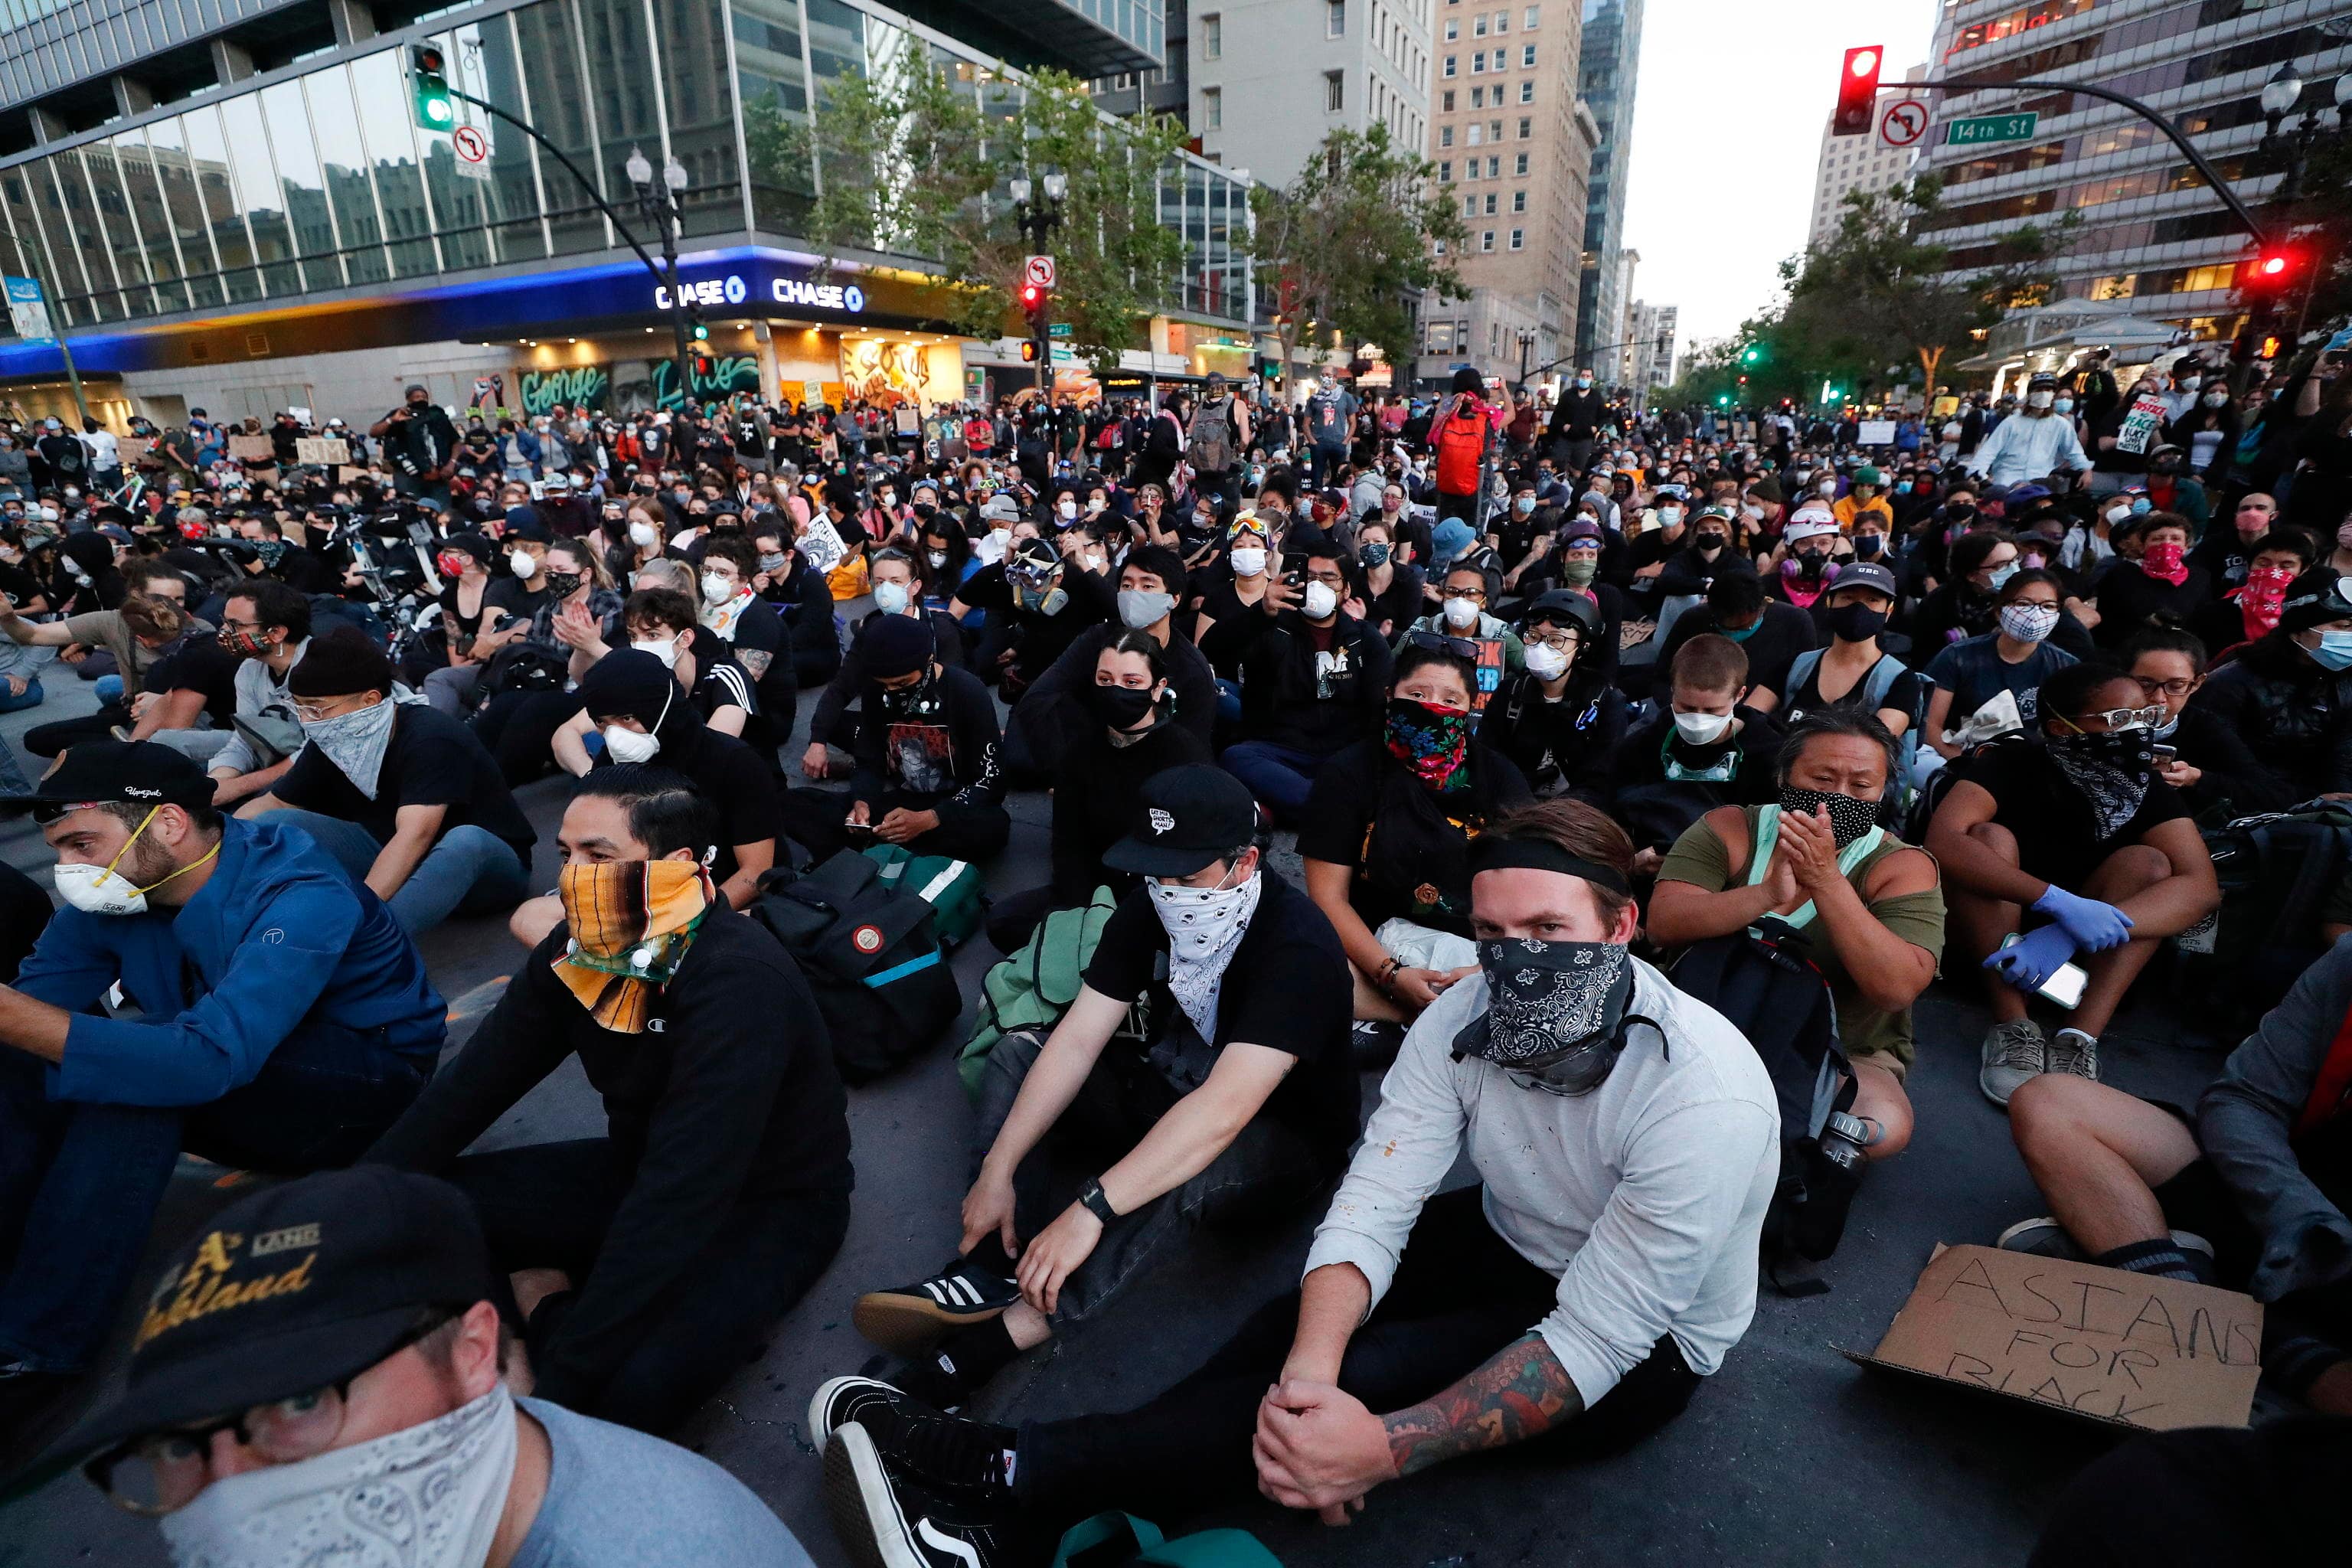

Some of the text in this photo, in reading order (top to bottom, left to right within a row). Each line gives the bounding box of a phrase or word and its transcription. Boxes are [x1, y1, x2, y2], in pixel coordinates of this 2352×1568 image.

[1958, 119, 2027, 140] 14th St
[773, 278, 844, 309] CHASE
[521, 366, 607, 413] George
[2132, 401, 2167, 415] JUSTICE
[2124, 416, 2155, 430] PEACE
[305, 439, 343, 460] BLM
[1934, 1258, 2259, 1366] ASIANS
[2005, 1330, 2160, 1390] FOR
